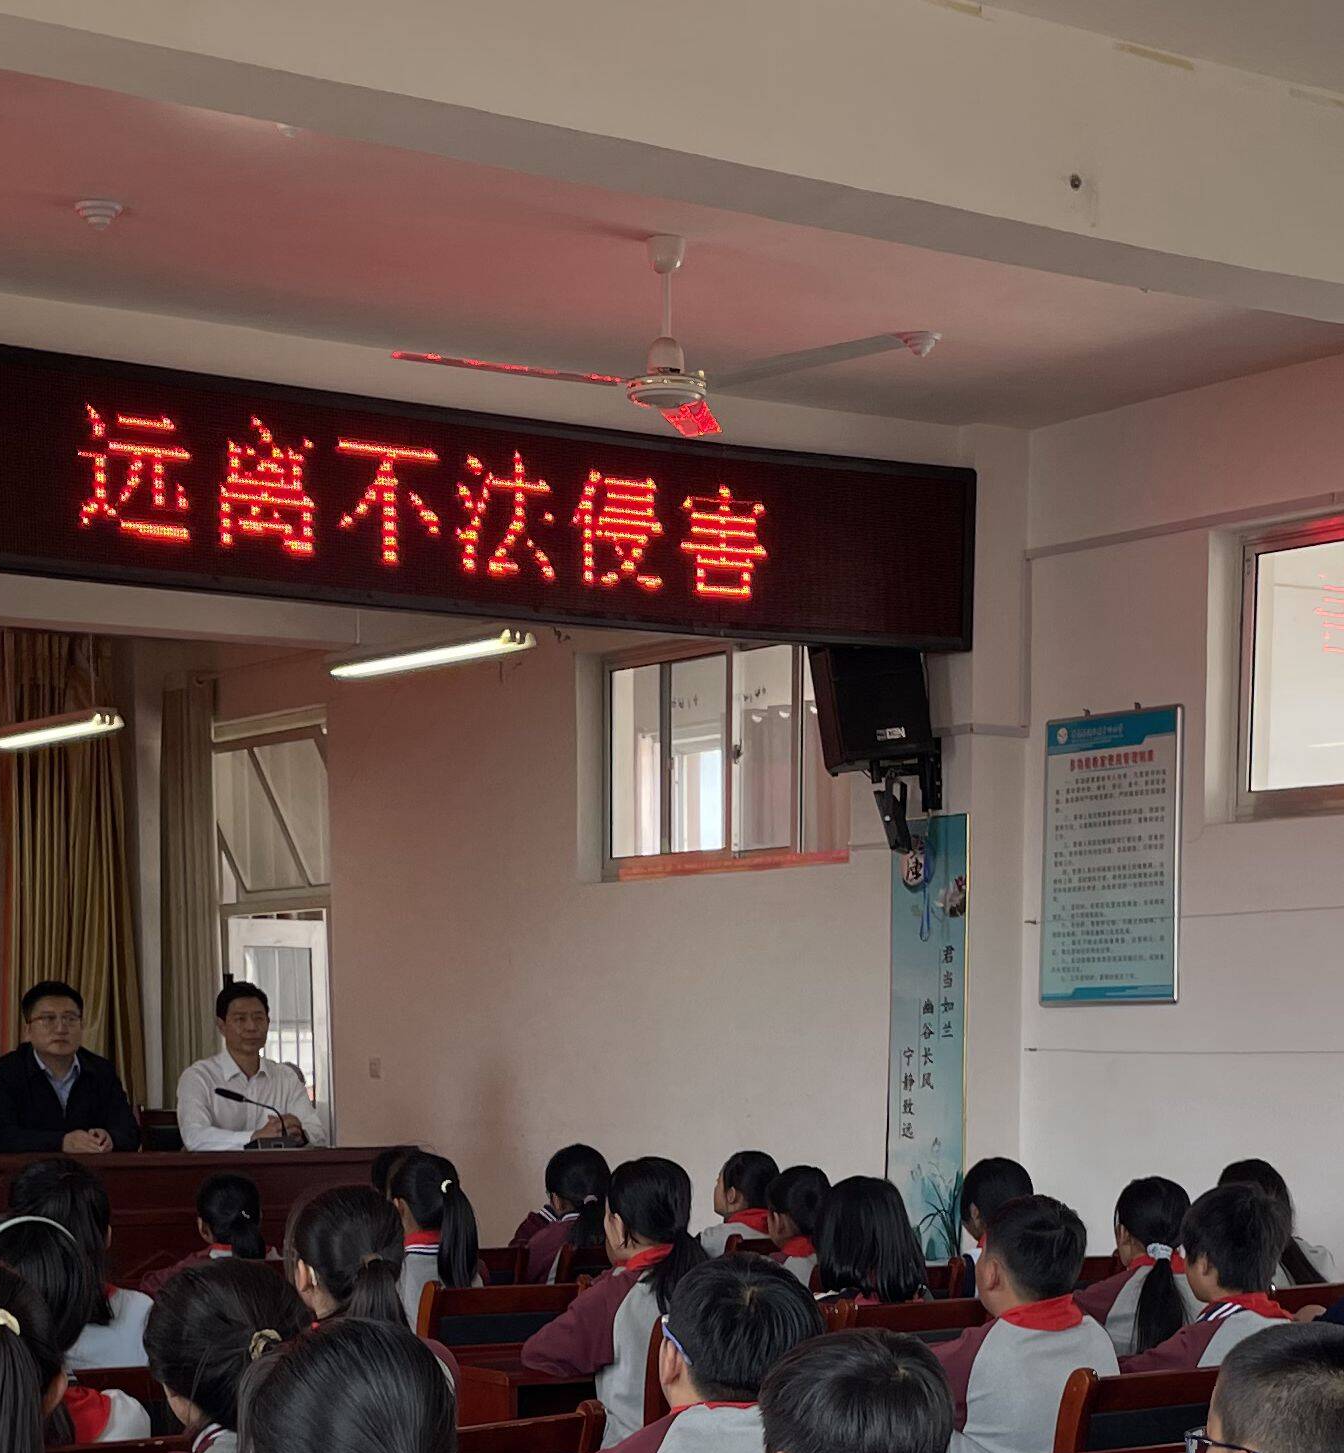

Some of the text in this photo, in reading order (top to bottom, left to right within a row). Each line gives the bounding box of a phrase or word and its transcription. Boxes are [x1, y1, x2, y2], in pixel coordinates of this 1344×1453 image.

[78, 404, 768, 599] 远离不法侵害
[940, 945, 955, 1038] 君当如兰
[901, 1046, 915, 1139] 宁静致远
